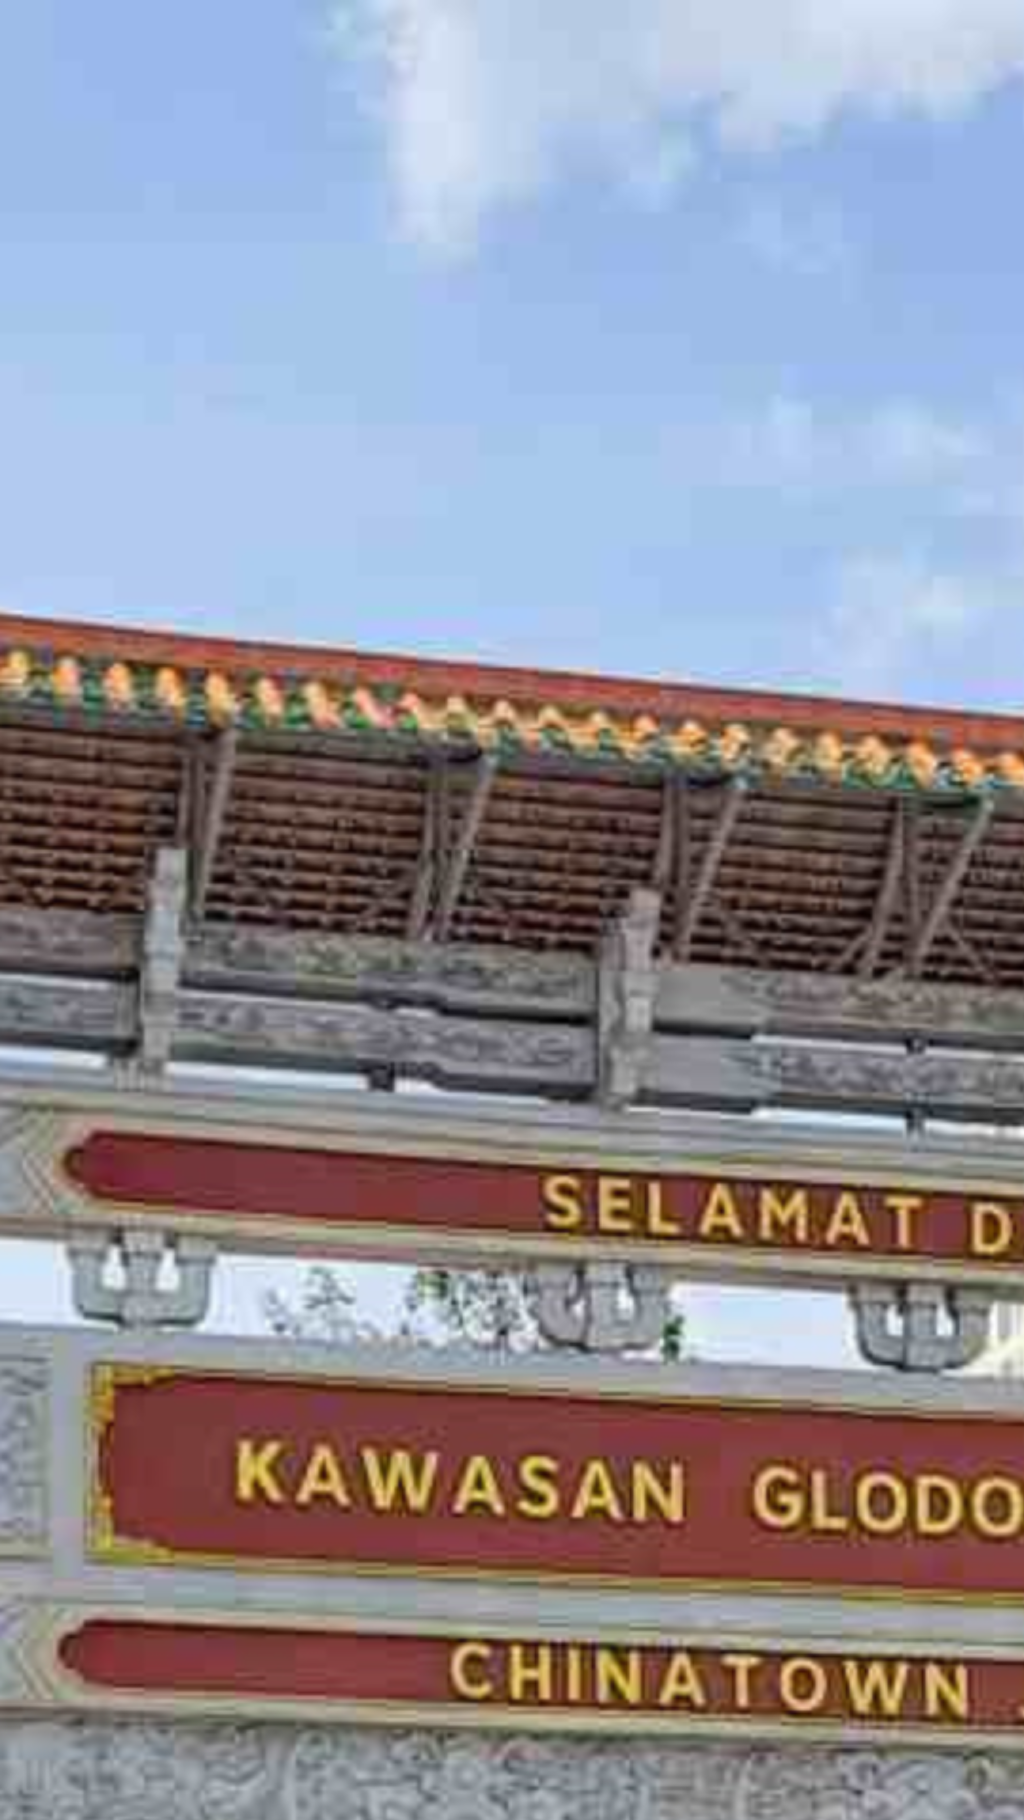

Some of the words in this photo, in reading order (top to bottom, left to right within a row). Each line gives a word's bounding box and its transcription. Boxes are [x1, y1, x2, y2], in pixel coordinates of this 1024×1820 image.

[542, 1173, 922, 1249] SELAMAT
[236, 1439, 687, 1522] KAWASAN
[449, 1641, 969, 1718] CHINATOWN
